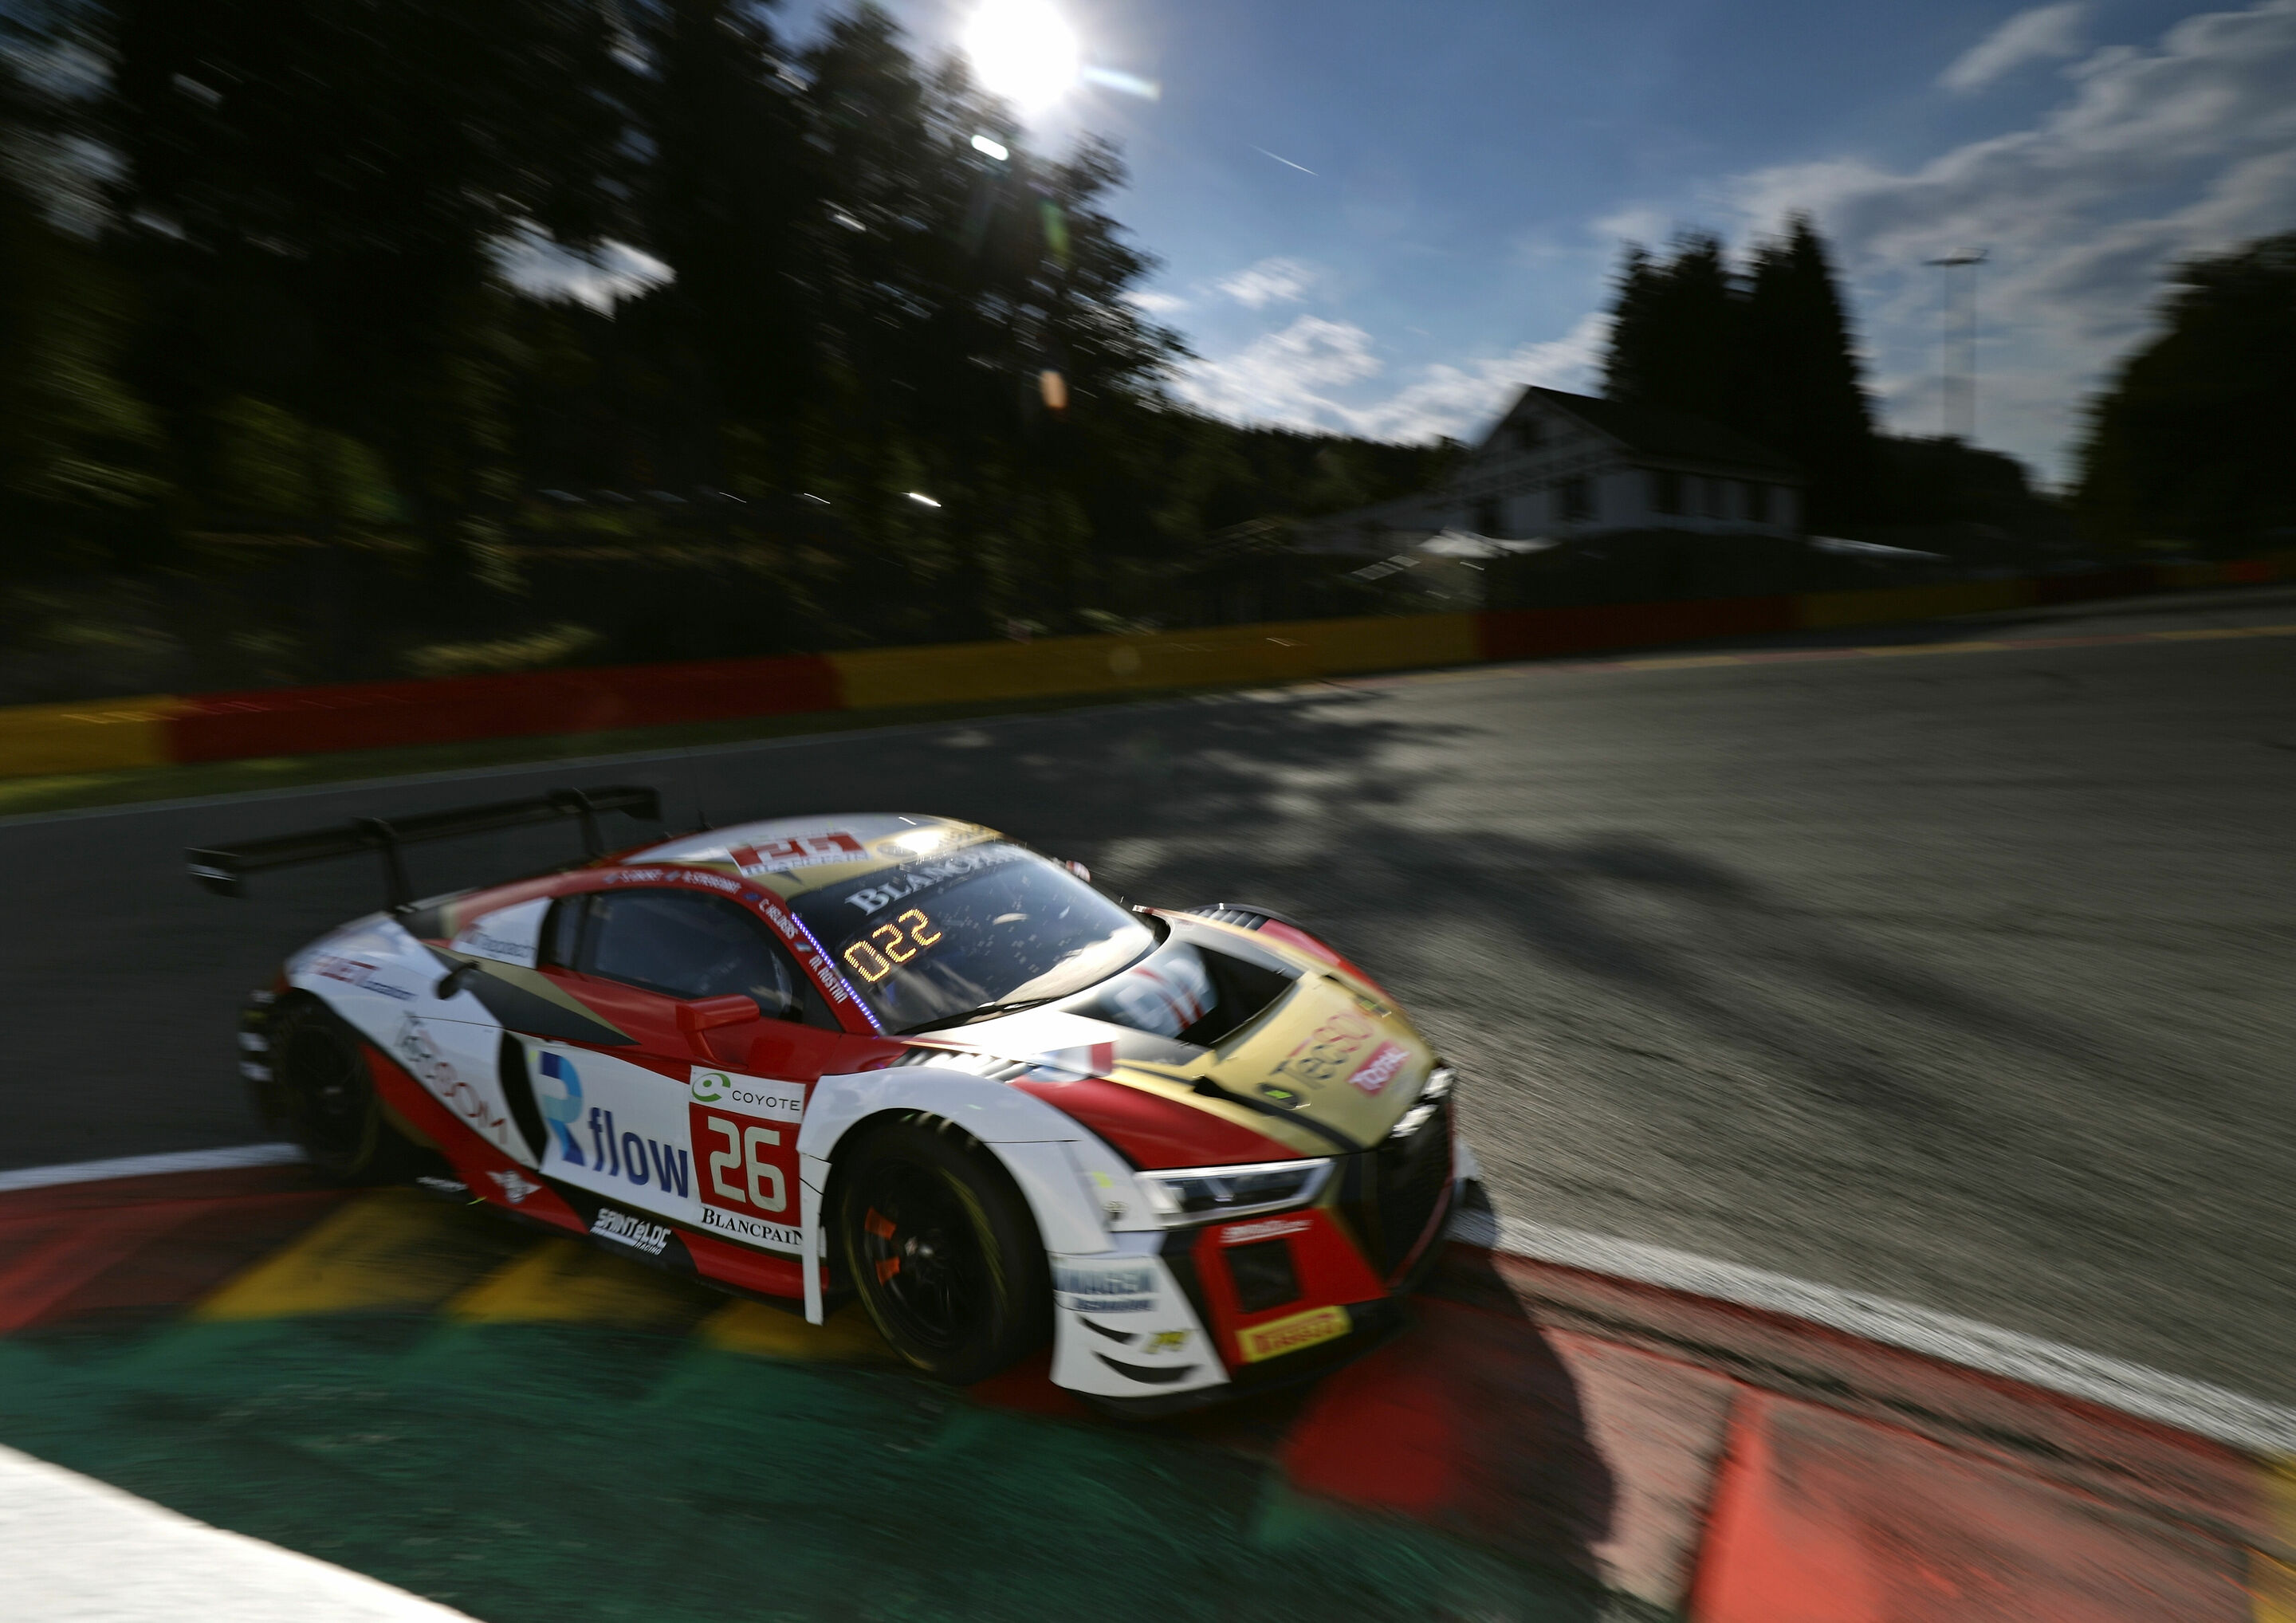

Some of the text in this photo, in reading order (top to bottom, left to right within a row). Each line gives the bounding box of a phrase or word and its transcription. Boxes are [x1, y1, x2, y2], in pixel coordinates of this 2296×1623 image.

[843, 908, 942, 982] 022
[732, 1090, 800, 1111] COYOTE
[707, 1115, 787, 1212] 26
[701, 1208, 804, 1246] BLANCPAIN
